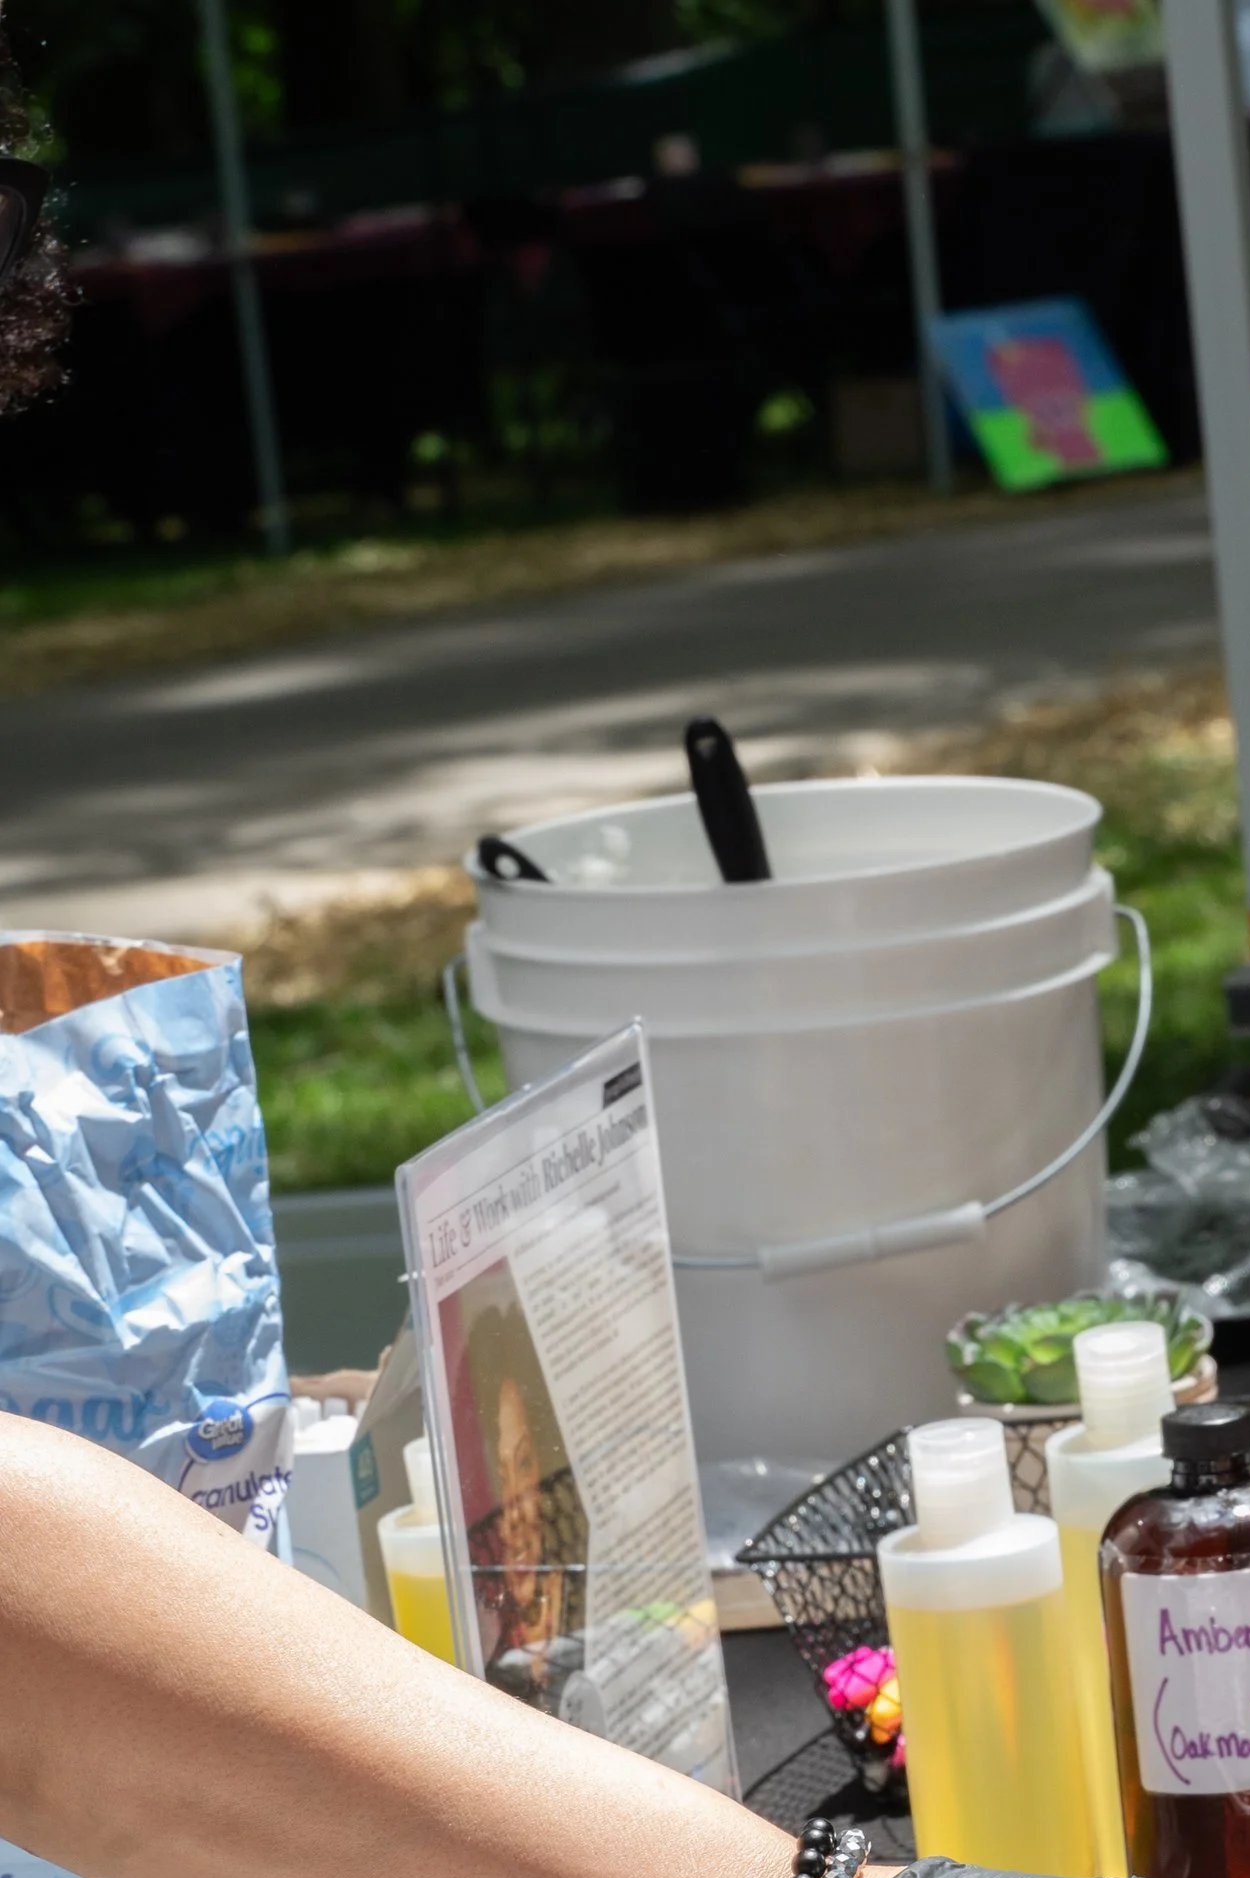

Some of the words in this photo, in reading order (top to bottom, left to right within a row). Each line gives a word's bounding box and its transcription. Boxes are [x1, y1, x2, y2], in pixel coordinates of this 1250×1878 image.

[429, 1220, 457, 1268] Life
[459, 1209, 472, 1248] &
[473, 1185, 509, 1235] Work
[509, 1162, 543, 1209] with
[541, 1130, 597, 1193] Richelle
